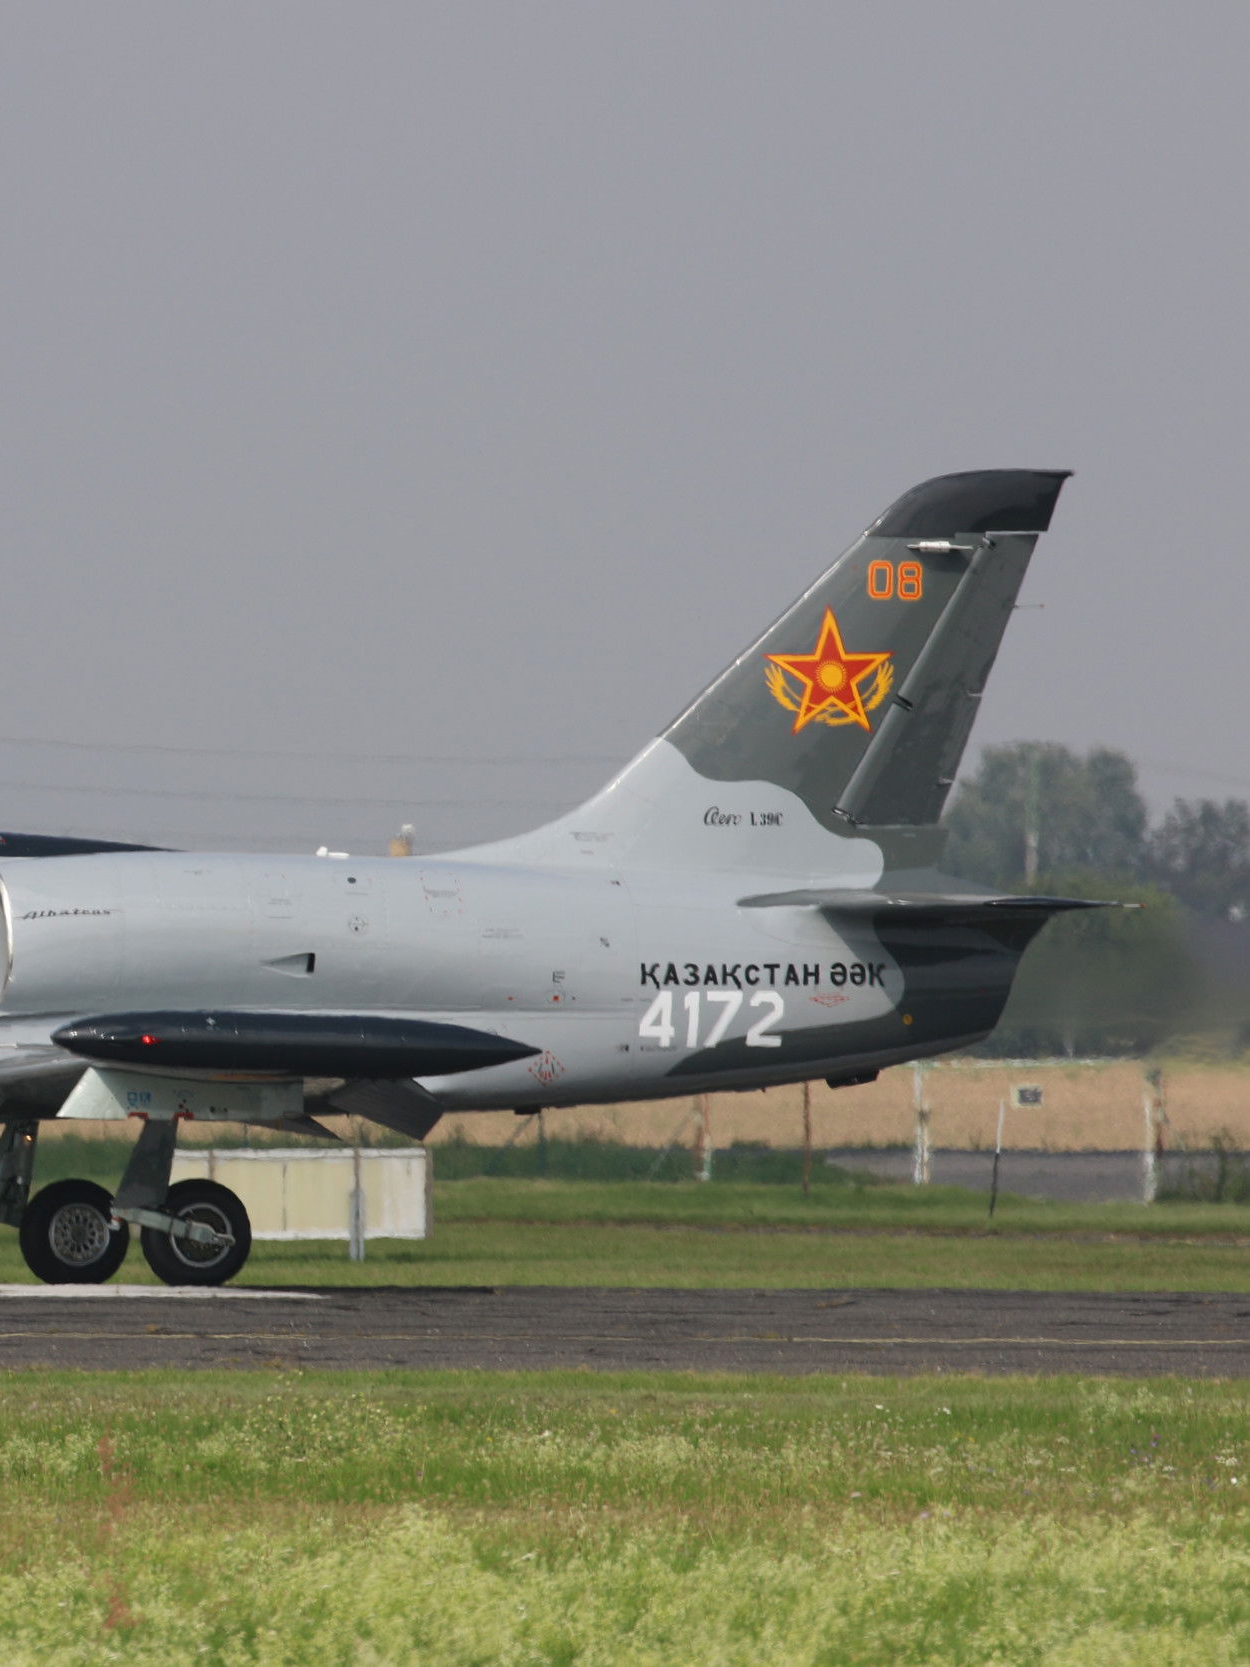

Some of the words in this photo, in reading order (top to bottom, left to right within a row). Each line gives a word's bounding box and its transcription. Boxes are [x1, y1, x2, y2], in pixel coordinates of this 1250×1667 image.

[868, 560, 922, 600] 08
[640, 962, 820, 990] ҚАЗАҚСТАН
[639, 990, 784, 1048] 4172
